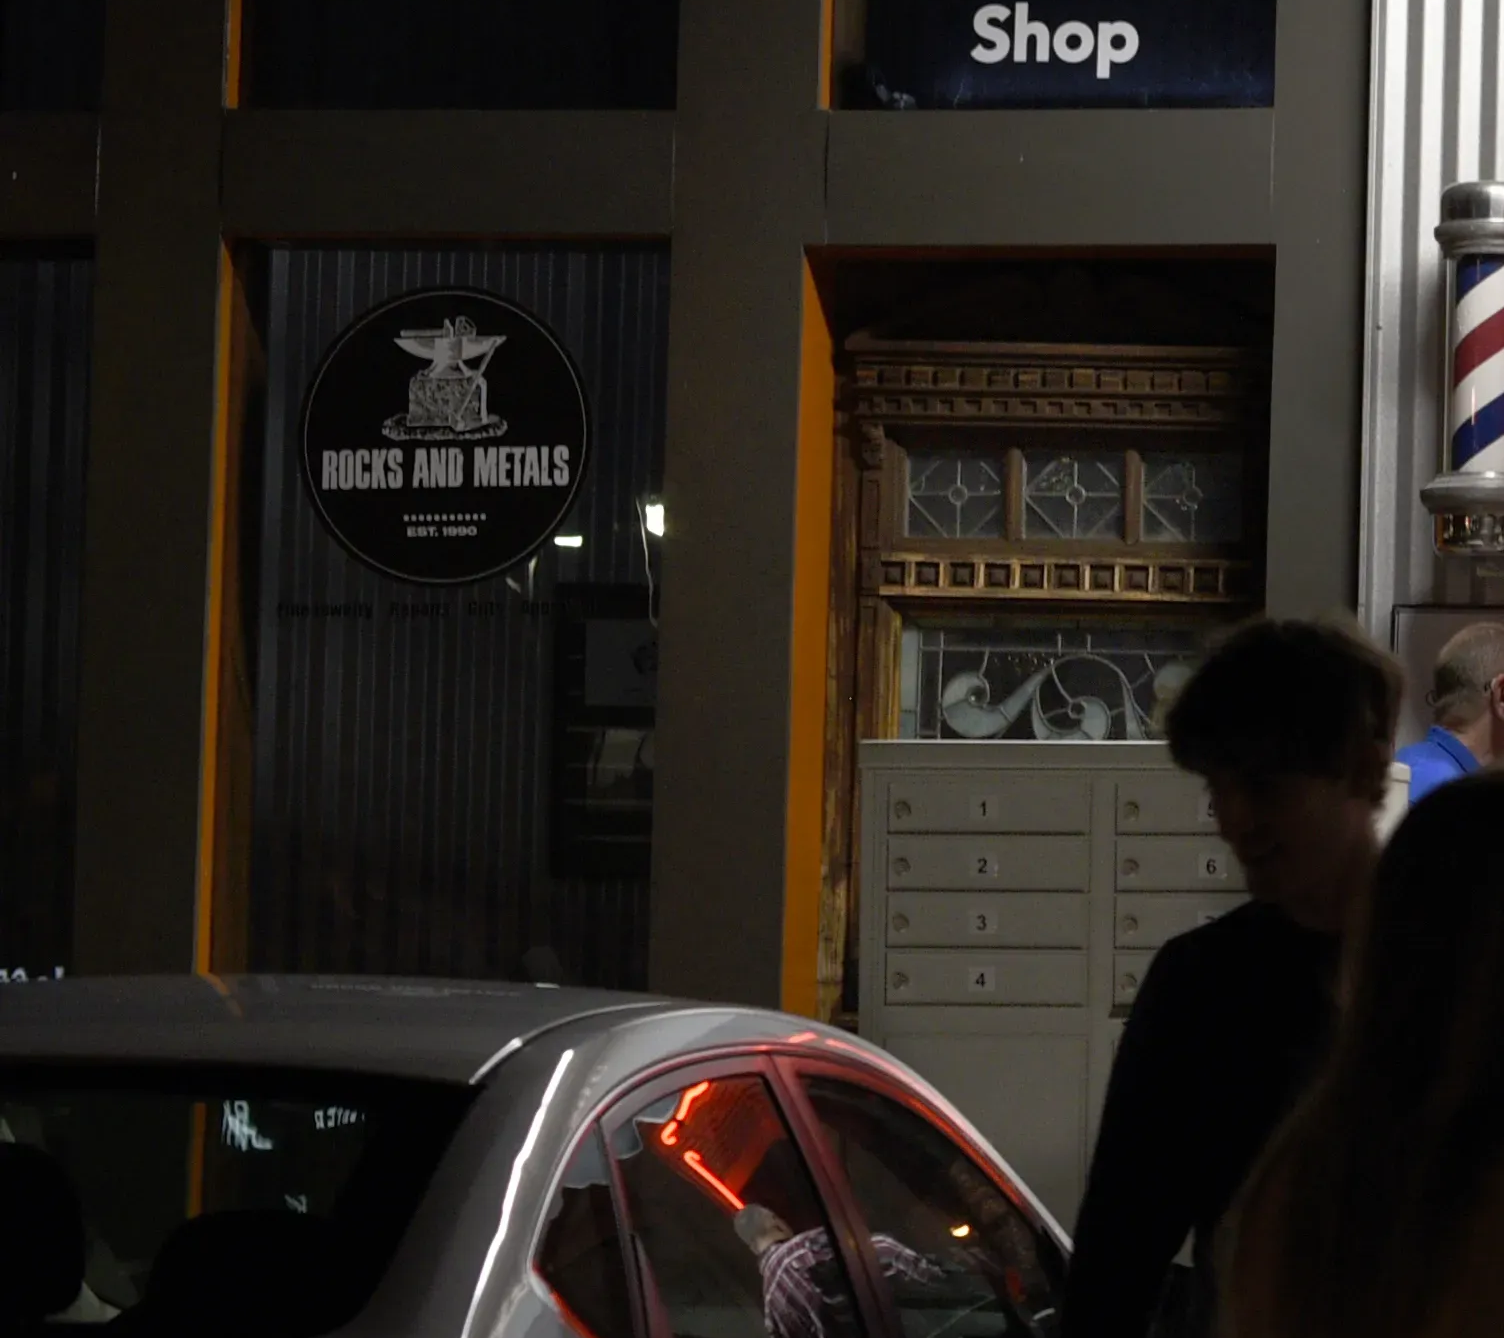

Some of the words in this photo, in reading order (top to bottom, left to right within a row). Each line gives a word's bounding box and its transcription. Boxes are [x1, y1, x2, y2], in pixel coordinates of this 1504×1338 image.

[970, 2, 1139, 79] Shop
[321, 446, 404, 491] ROCKS
[412, 446, 464, 489] AND
[473, 444, 571, 488] METALS
[406, 526, 439, 538] EST.
[979, 802, 987, 816] 1
[977, 858, 988, 873] 2
[1206, 859, 1217, 874] 6
[976, 916, 987, 931] 3
[974, 973, 986, 988] 4
